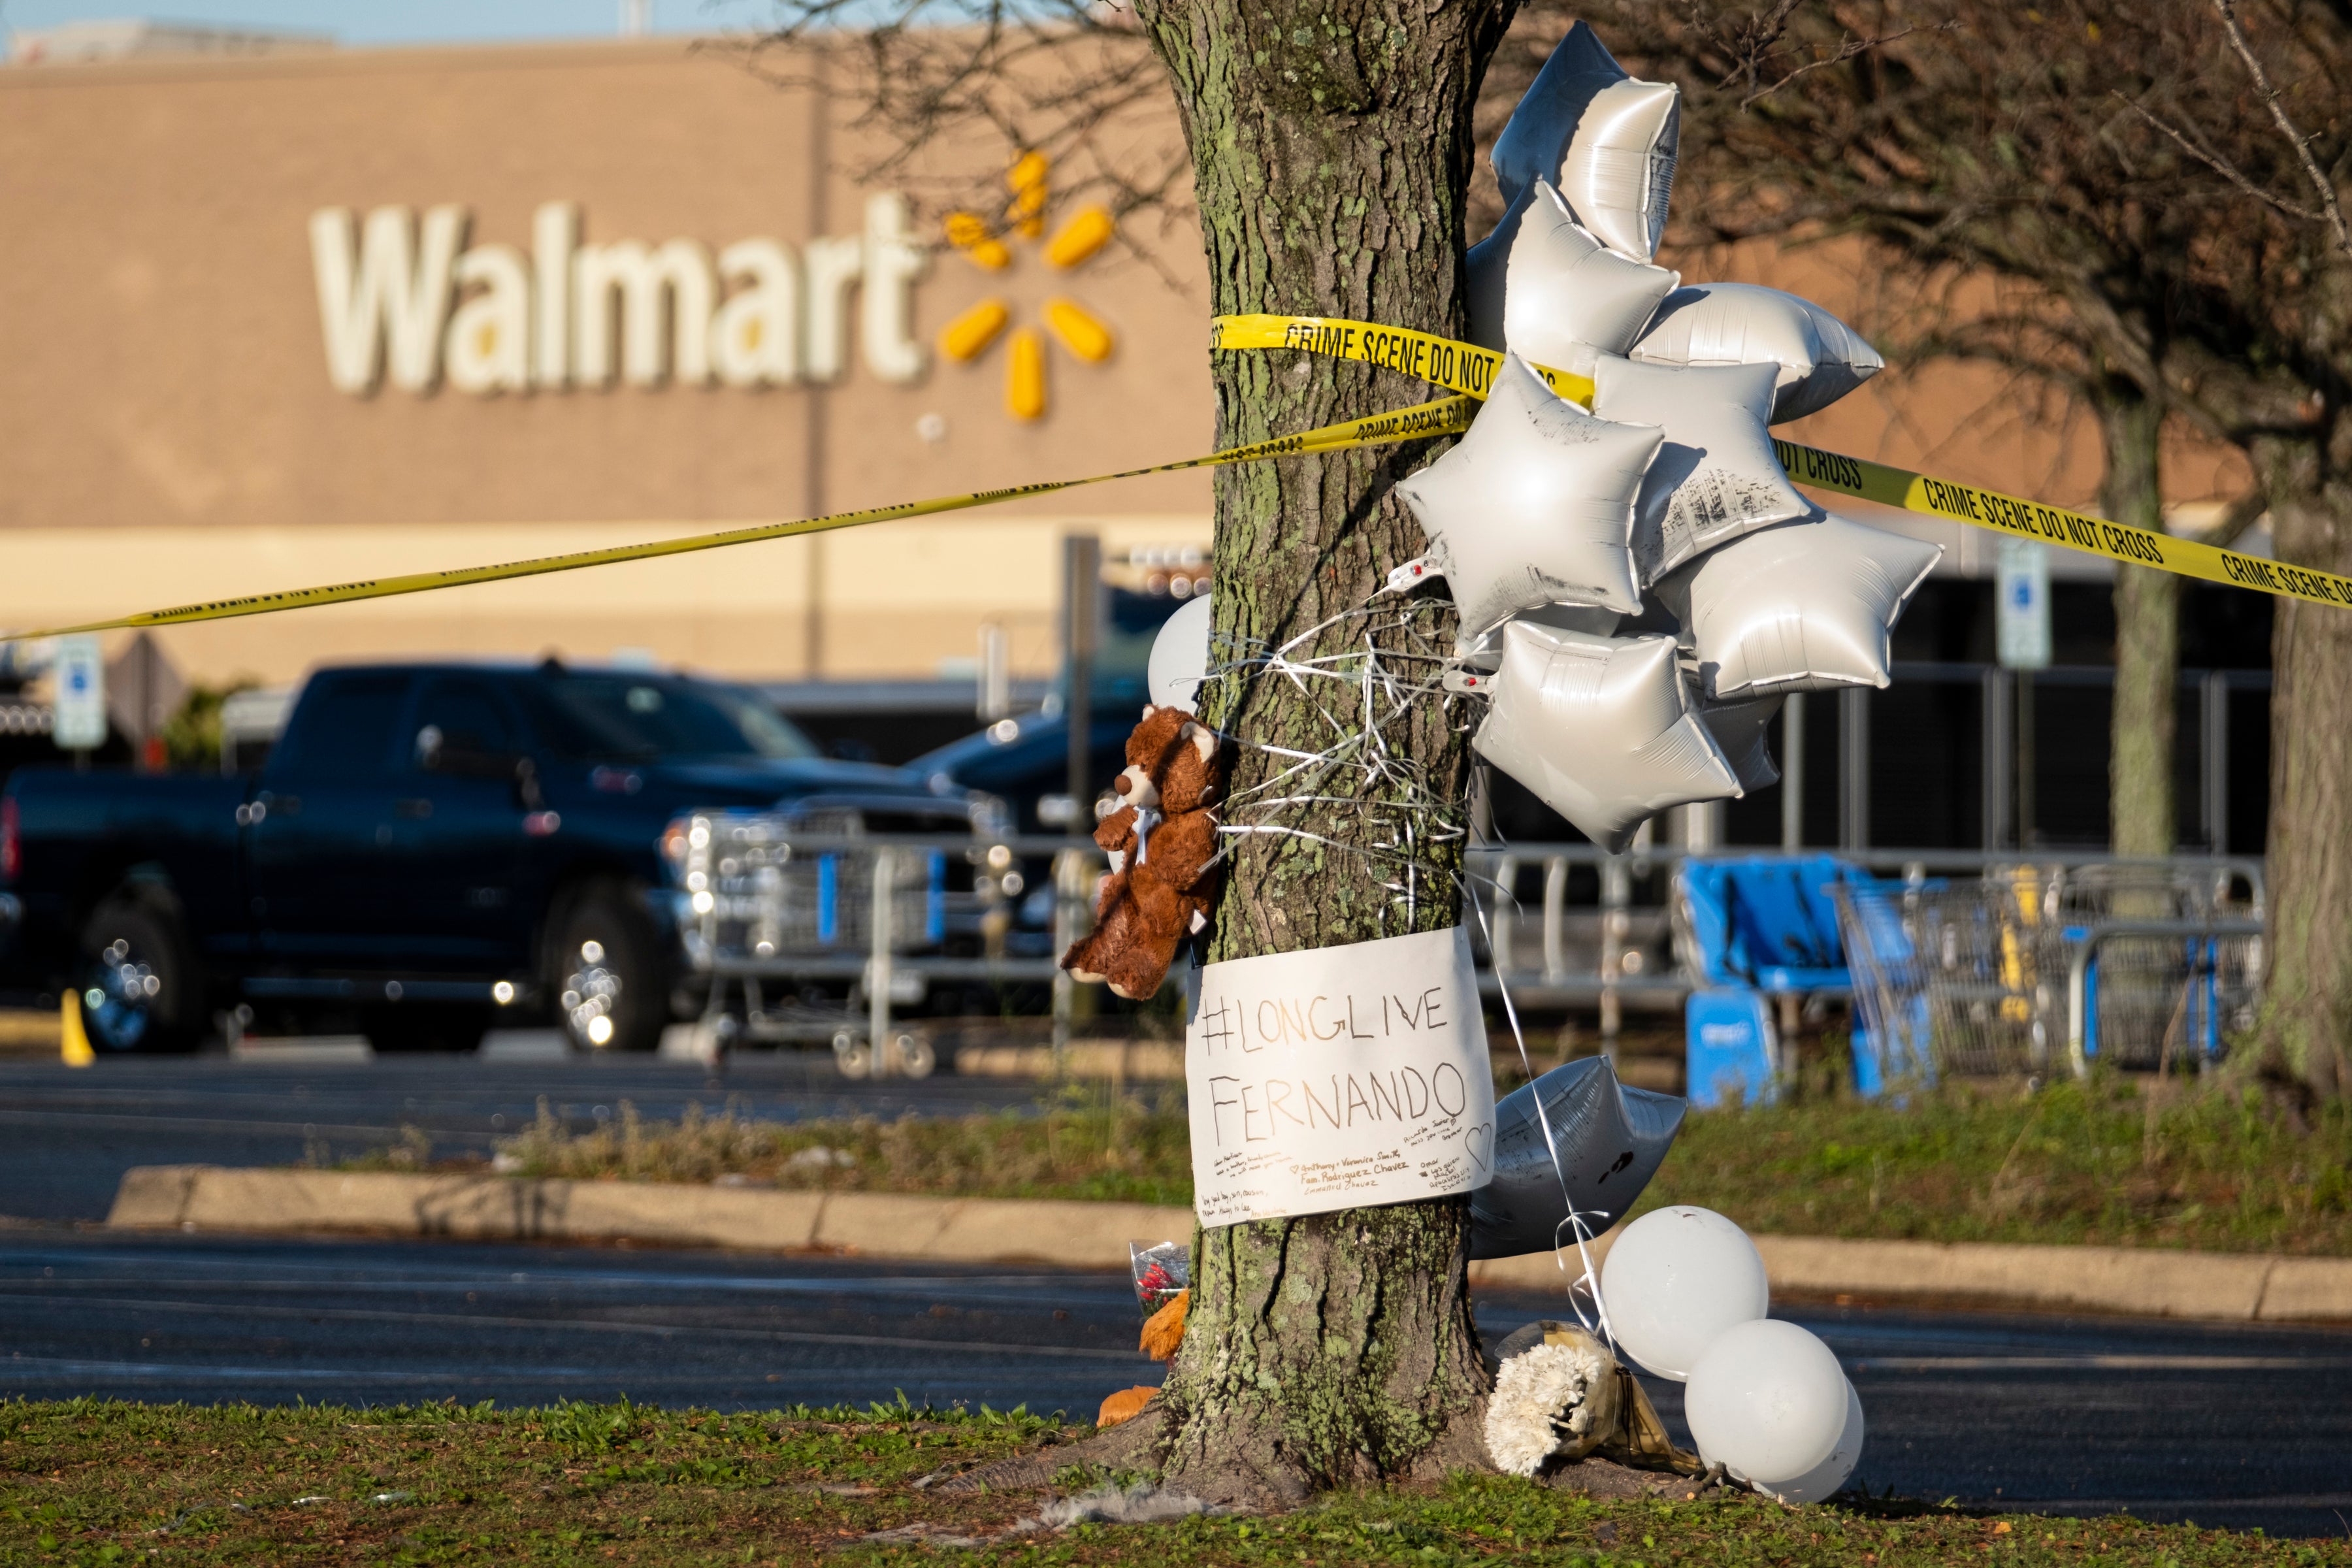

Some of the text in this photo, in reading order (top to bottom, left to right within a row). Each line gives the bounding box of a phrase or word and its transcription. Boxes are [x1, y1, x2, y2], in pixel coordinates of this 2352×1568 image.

[308, 191, 926, 393] Walmart
[1284, 323, 1354, 357] CRIME
[1361, 330, 1425, 378] SCENE
[1429, 342, 1454, 385] DO
[1459, 350, 1495, 395] NOT
[1804, 446, 1862, 490] CROSS
[1923, 478, 2164, 564] CRIME SCENE DO NOT CROSS
[2221, 553, 2283, 591] CRIME
[2277, 566, 2340, 602] SCENE
[1208, 1062, 1465, 1147] FERNANDO
[1301, 1162, 1335, 1173] Anthony
[1341, 1156, 1373, 1167] Veronica
[1321, 1169, 1372, 1184] Rodriguez
[1373, 1161, 1409, 1174] Chavez
